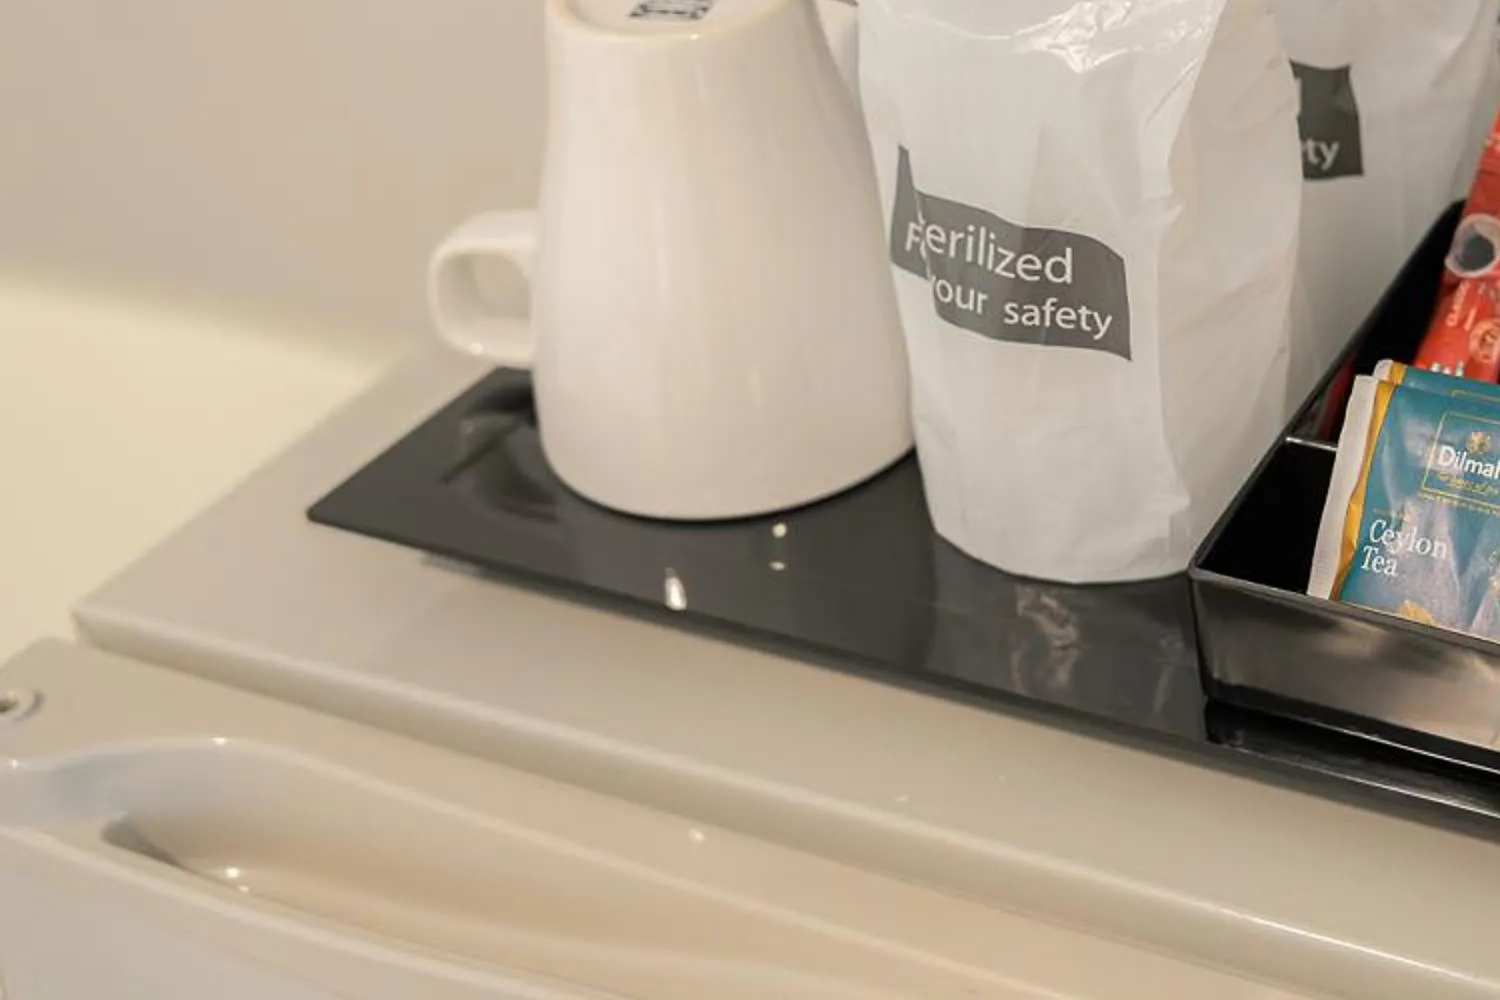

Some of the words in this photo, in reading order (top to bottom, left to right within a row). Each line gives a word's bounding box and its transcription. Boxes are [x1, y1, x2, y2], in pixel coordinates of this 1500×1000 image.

[1004, 298, 1113, 339] safety
[1369, 519, 1448, 560] Ceylon
[1361, 545, 1399, 577] Tea
